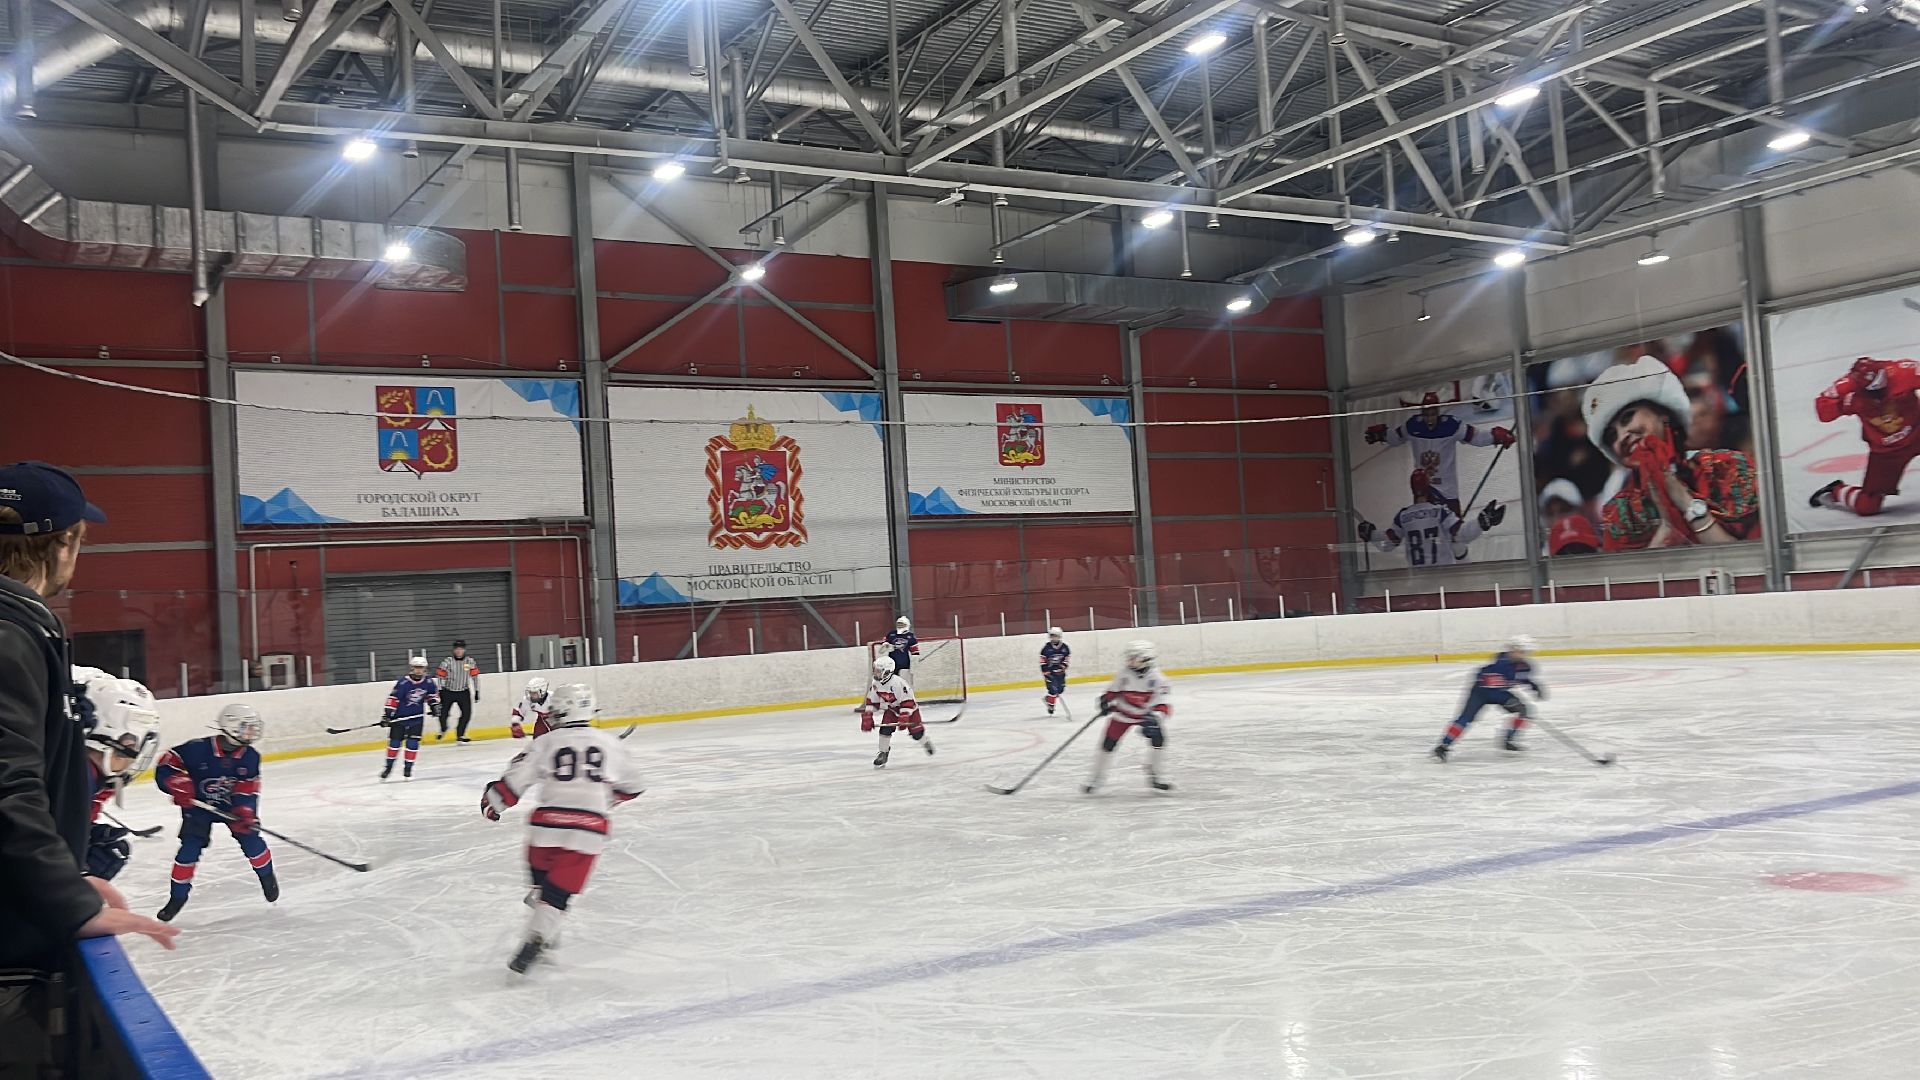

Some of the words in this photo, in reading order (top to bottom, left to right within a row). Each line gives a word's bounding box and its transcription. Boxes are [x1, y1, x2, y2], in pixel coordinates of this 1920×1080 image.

[993, 477, 1057, 485] МИНИСТЕРСТВО
[356, 491, 437, 505] ГОРОДСКОЙ
[440, 492, 481, 503] ОКРУГ
[958, 487, 1011, 497] ФИЗИЧЕСКОЙ
[1012, 487, 1052, 496] КУЛЬТУРЫ
[1060, 487, 1090, 496] СПОРТА
[981, 498, 1036, 507] МОСКОВСКОЙ
[1037, 498, 1072, 507] ОБЛАСТИ
[381, 506, 460, 518] БАЛАШИХА
[1407, 526, 1439, 566] 87
[708, 561, 812, 577] ПРАВИТЕЛЬСТВО
[687, 575, 775, 591] МОСКОВСКОЙ
[777, 574, 833, 586] ОБЛАСТИ
